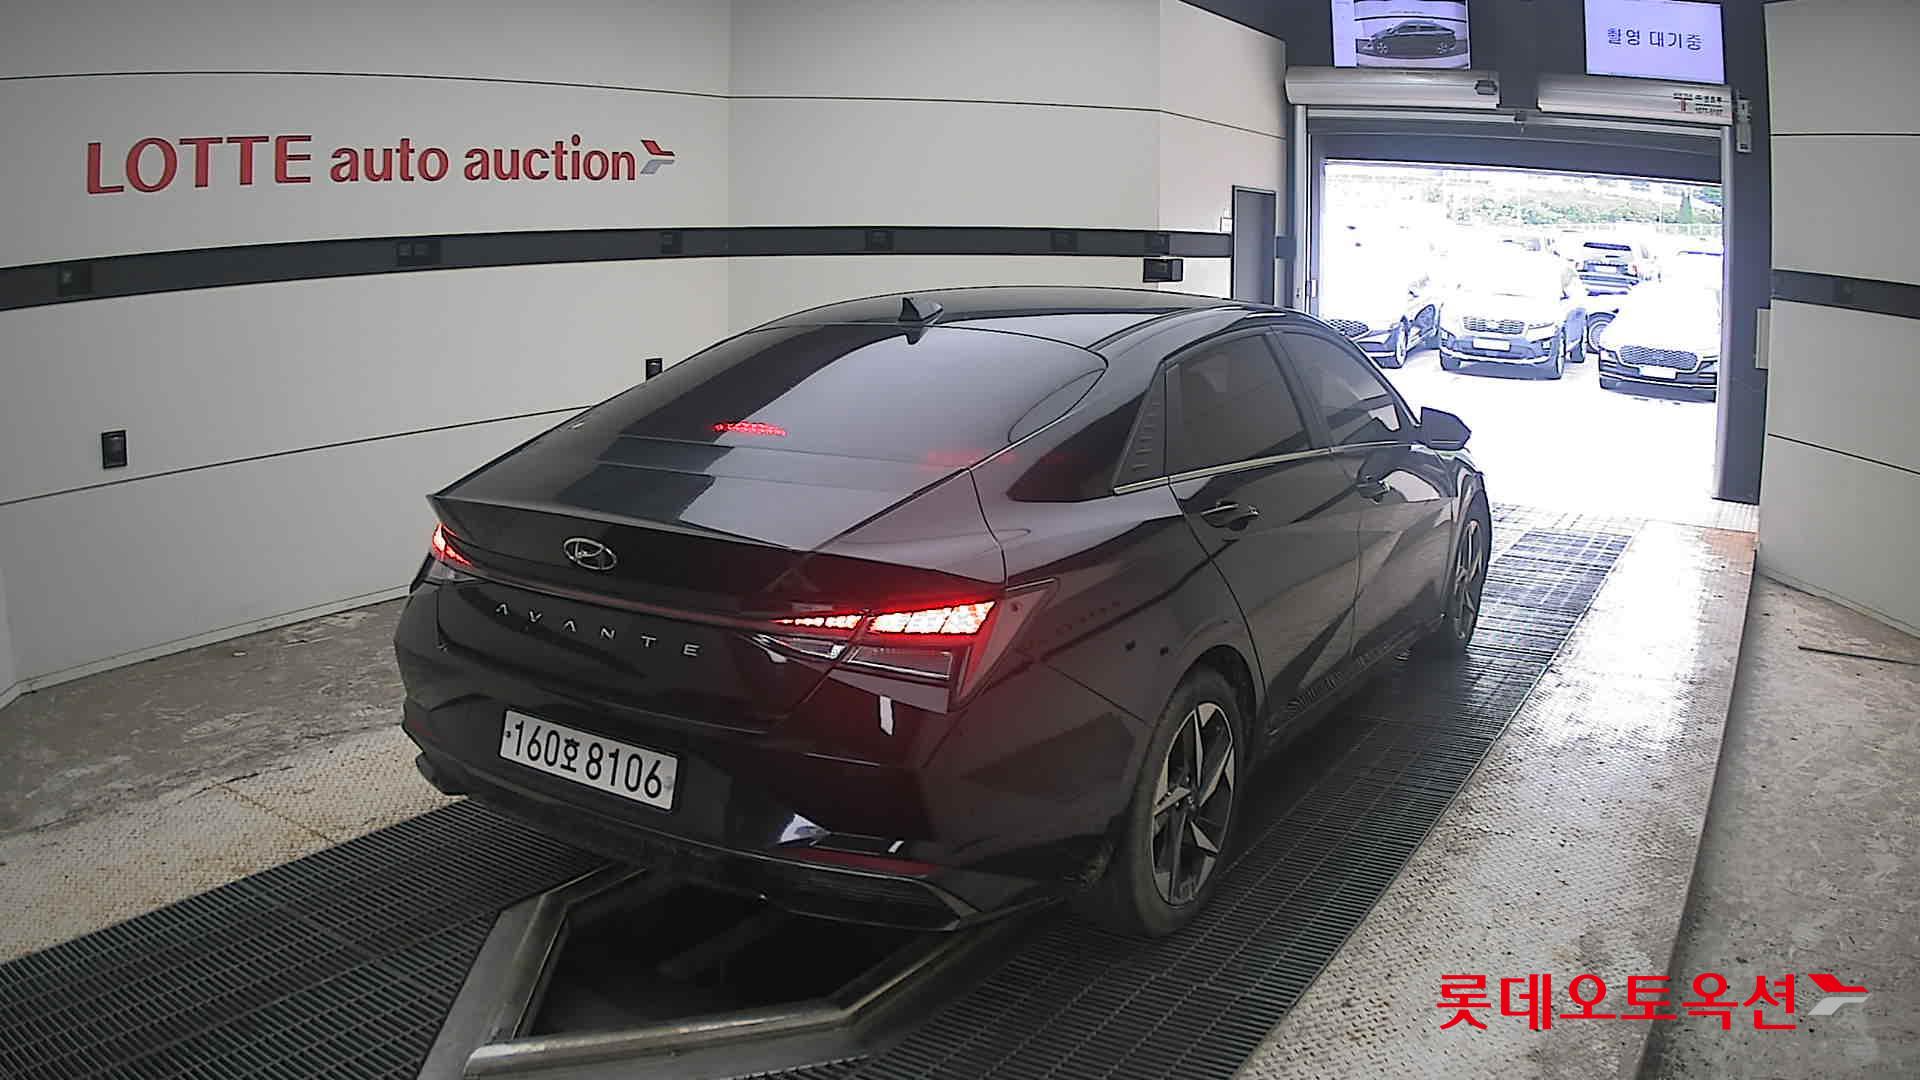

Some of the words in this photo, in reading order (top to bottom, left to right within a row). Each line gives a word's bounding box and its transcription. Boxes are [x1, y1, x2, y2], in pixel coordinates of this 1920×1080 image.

[1649, 31, 1701, 51] 대기중
[86, 134, 312, 194] LOTTE
[329, 137, 449, 182] auto
[463, 133, 636, 182] auction
[495, 602, 700, 657] AVANTE
[514, 719, 663, 799] 160호8106
